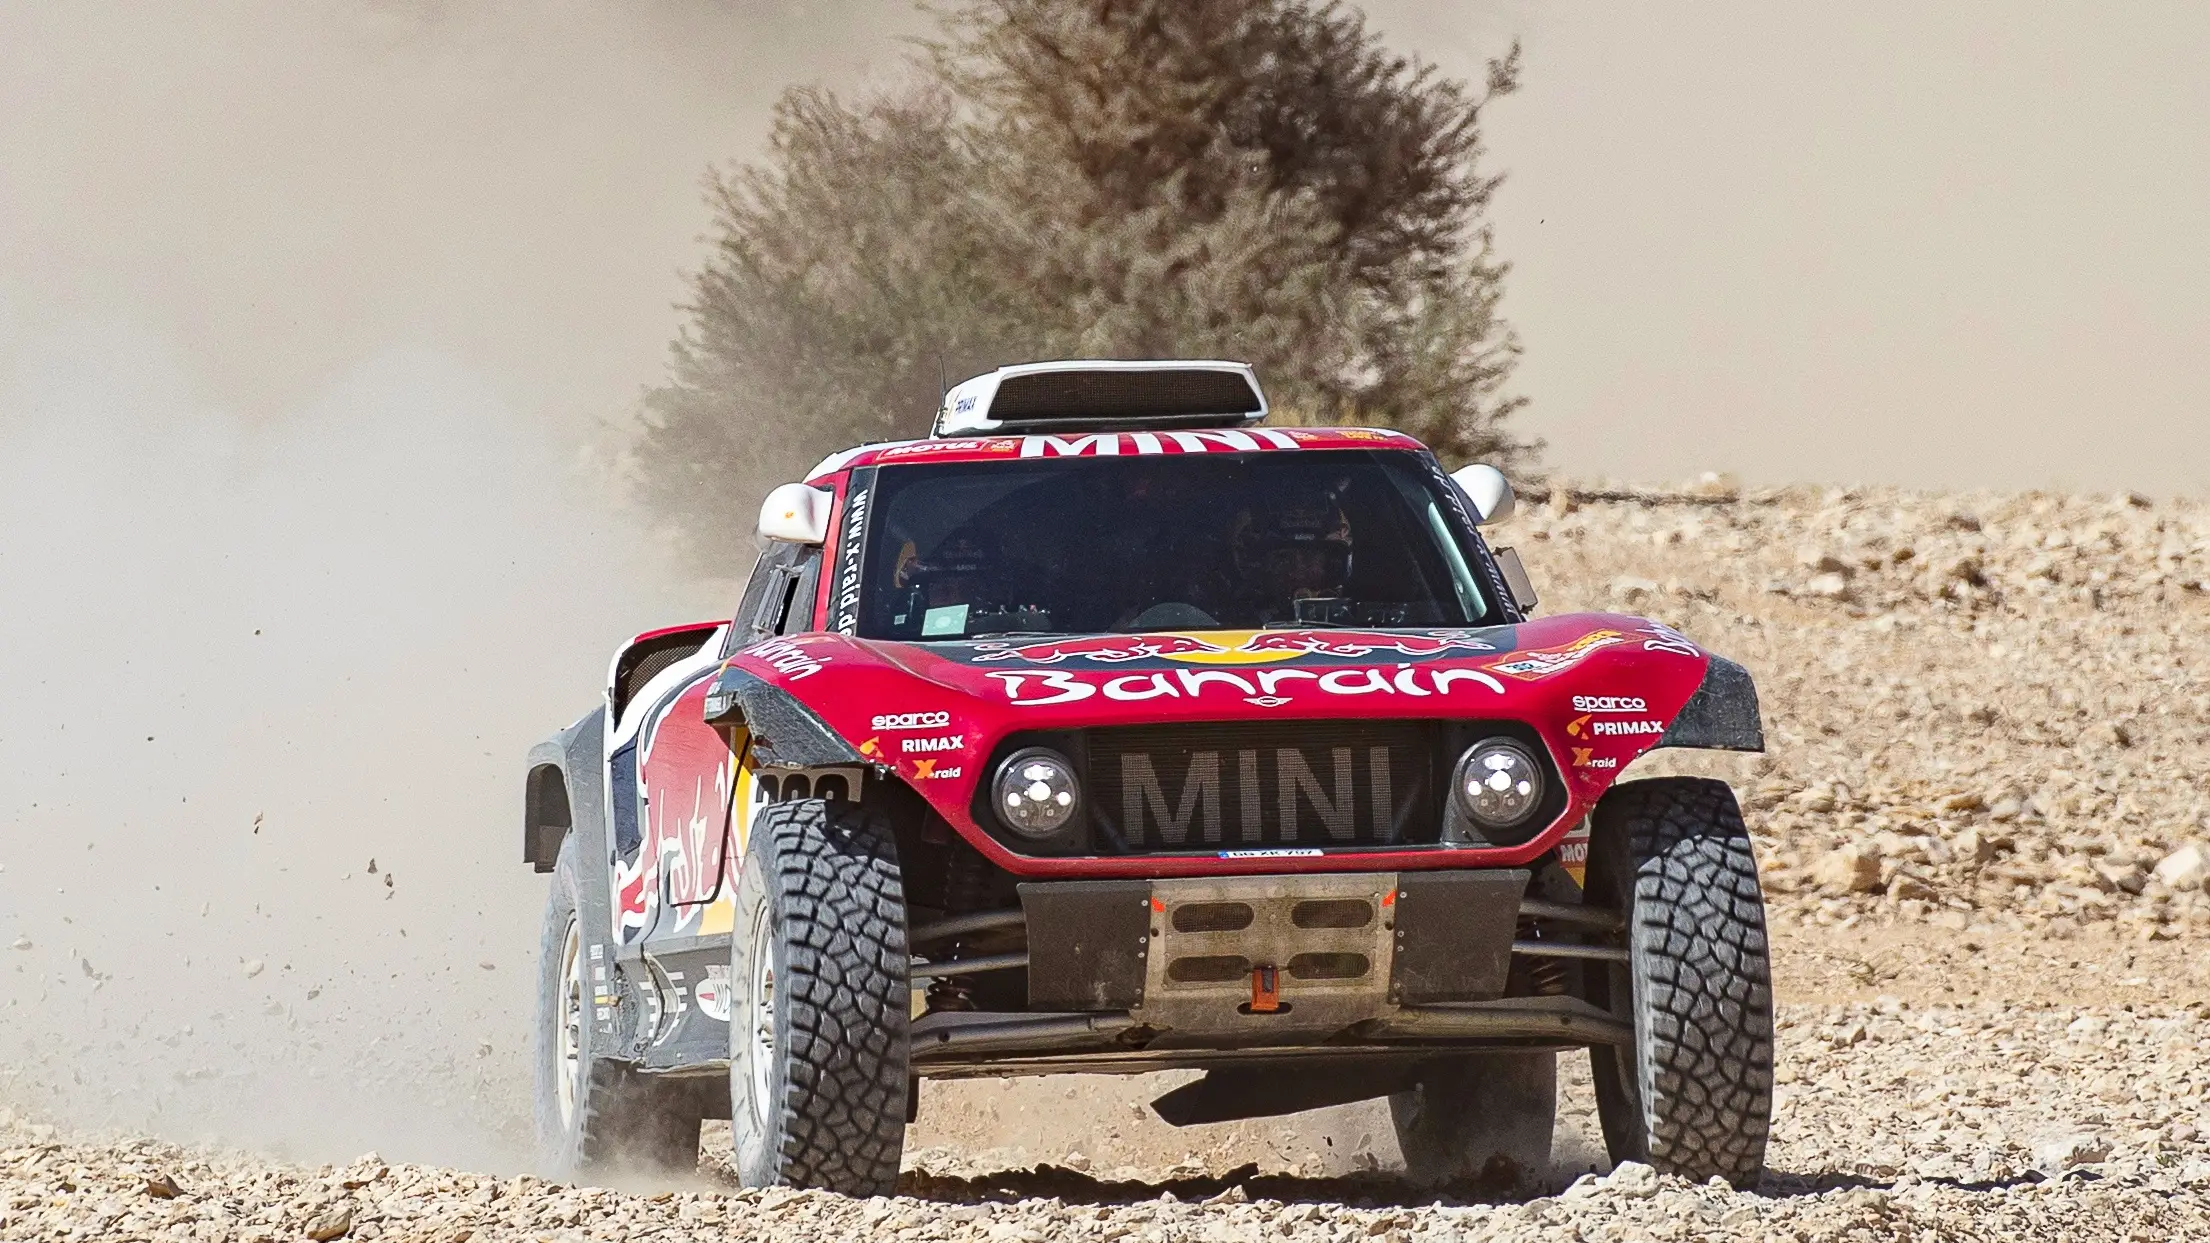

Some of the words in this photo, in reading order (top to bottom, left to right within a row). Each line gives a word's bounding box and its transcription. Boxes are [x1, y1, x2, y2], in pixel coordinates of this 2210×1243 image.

[884, 441, 978, 456] MOTUL
[1020, 428, 1300, 458] MINI
[837, 489, 868, 637] www.x-raid.de
[985, 663, 1506, 706] Bahrain
[1572, 695, 1648, 713] sparco
[871, 711, 950, 731] sparco
[1592, 720, 1665, 736] PRIMAX
[901, 735, 965, 753] RIMAX
[1120, 746, 1393, 845] MINI
